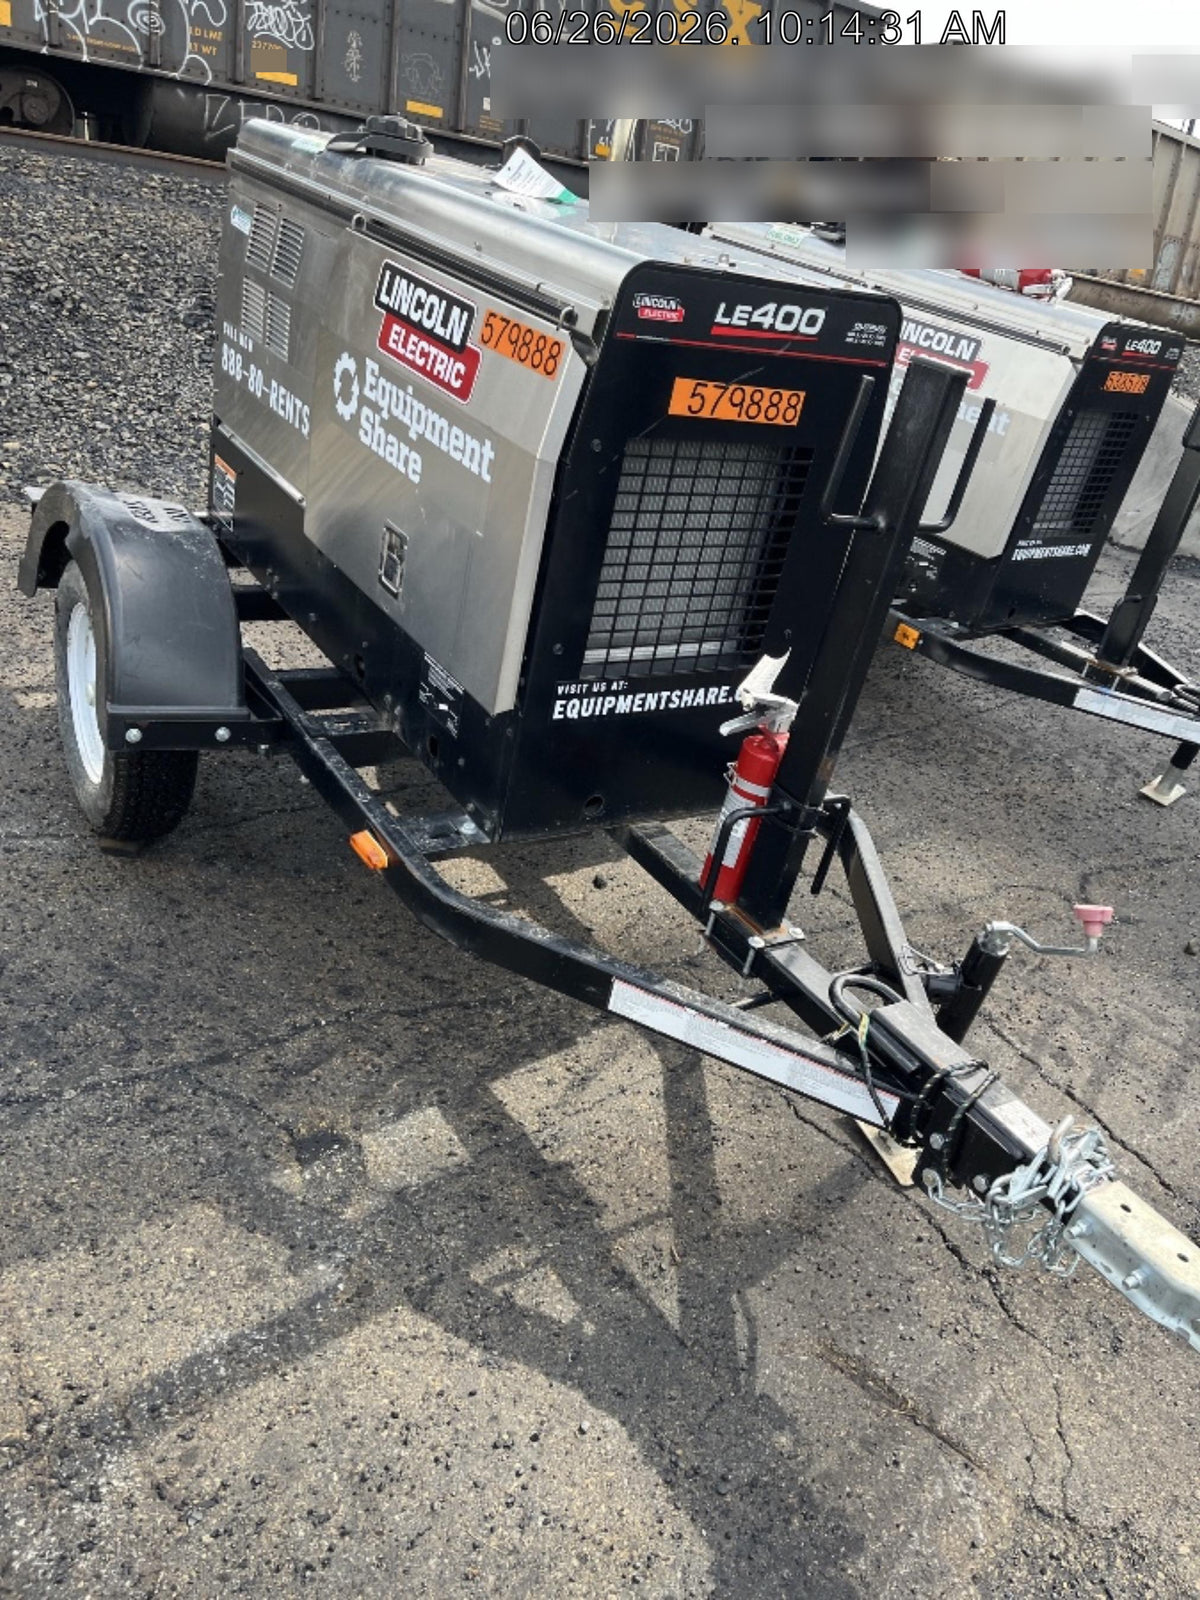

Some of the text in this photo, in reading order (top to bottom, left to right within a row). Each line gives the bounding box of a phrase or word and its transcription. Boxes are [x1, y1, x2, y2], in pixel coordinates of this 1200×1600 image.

[380, 269, 469, 346] LINCOLN
[633, 294, 681, 310] LINCOLN
[714, 302, 826, 335] LE400
[388, 323, 466, 389] ELECTRIC
[481, 312, 561, 376] 579888
[899, 320, 977, 362] INCOLN
[1124, 339, 1162, 355] LE400
[221, 343, 310, 438] 888-80-RENTS
[687, 382, 801, 423] 579888
[359, 405, 422, 484] Share
[363, 357, 495, 483] Equipment
[557, 681, 629, 695] VISIT US AT:
